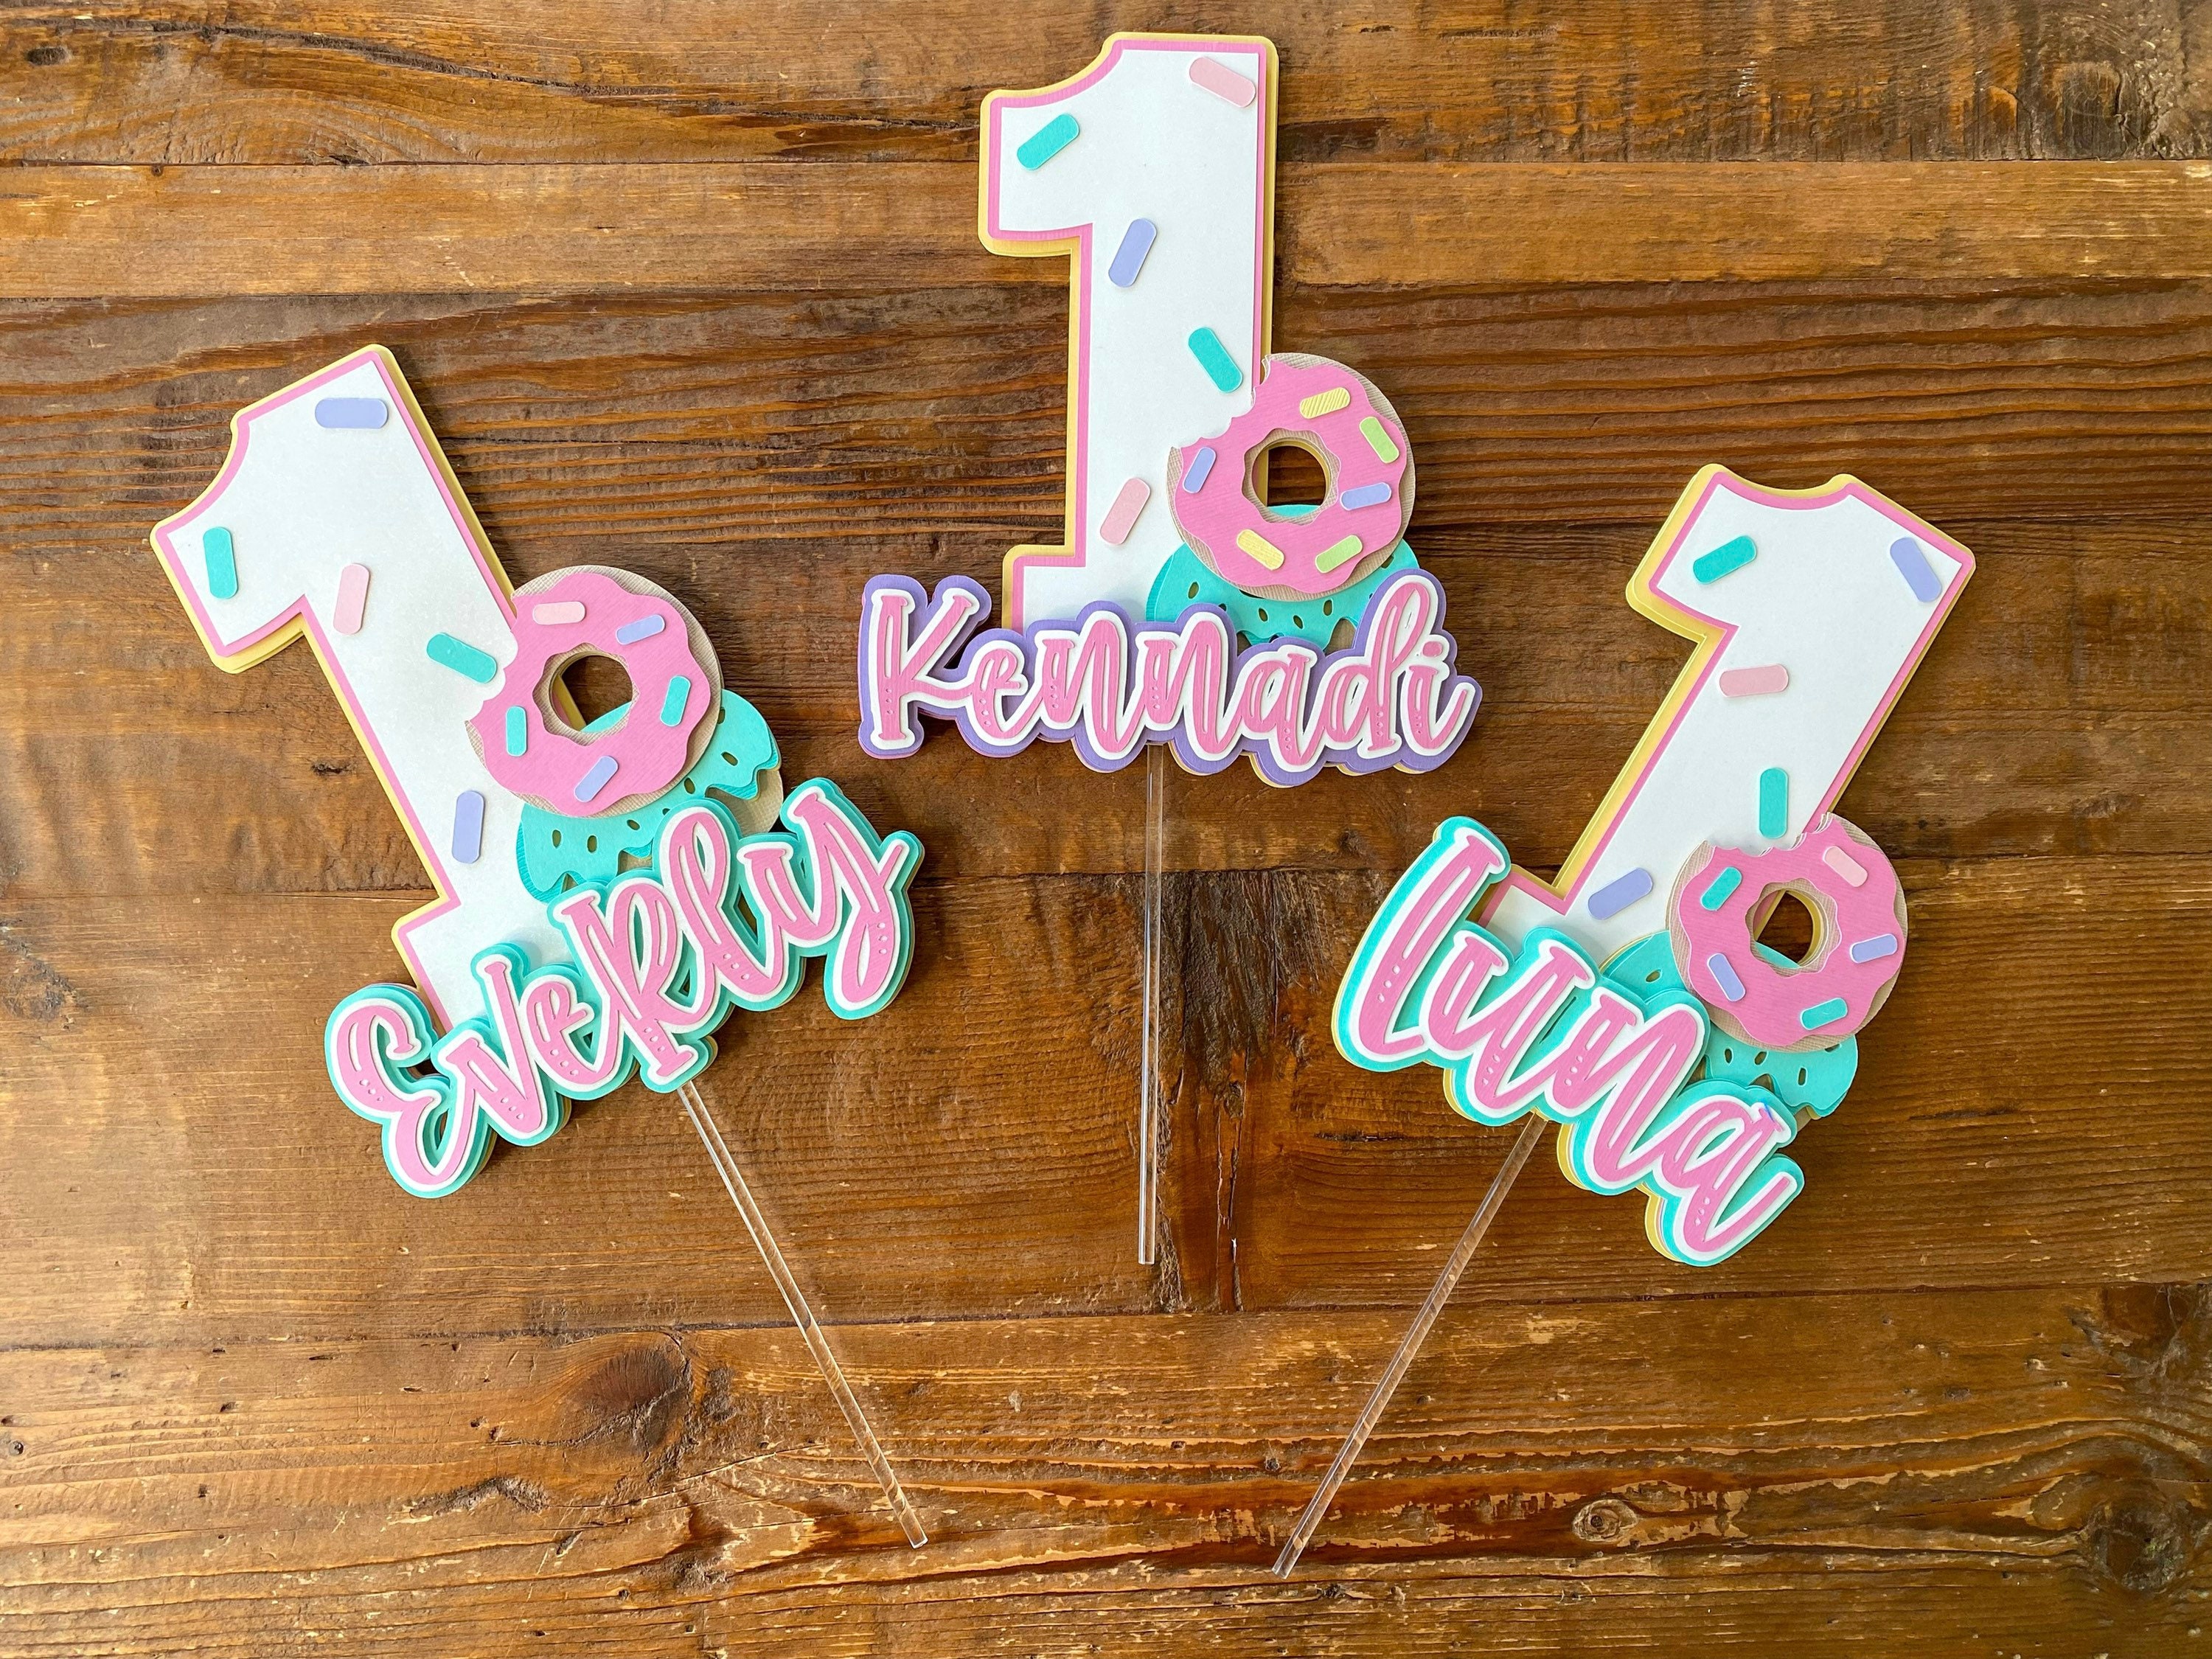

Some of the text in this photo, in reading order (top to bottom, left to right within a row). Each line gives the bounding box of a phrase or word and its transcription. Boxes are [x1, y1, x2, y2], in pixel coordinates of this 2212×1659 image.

[985, 35, 1270, 628] 1
[153, 349, 569, 1029] 1
[873, 577, 1473, 768] Kennadi
[1479, 470, 1972, 961] 1
[332, 786, 905, 1190] Everly
[1355, 829, 1795, 1255] Luna
